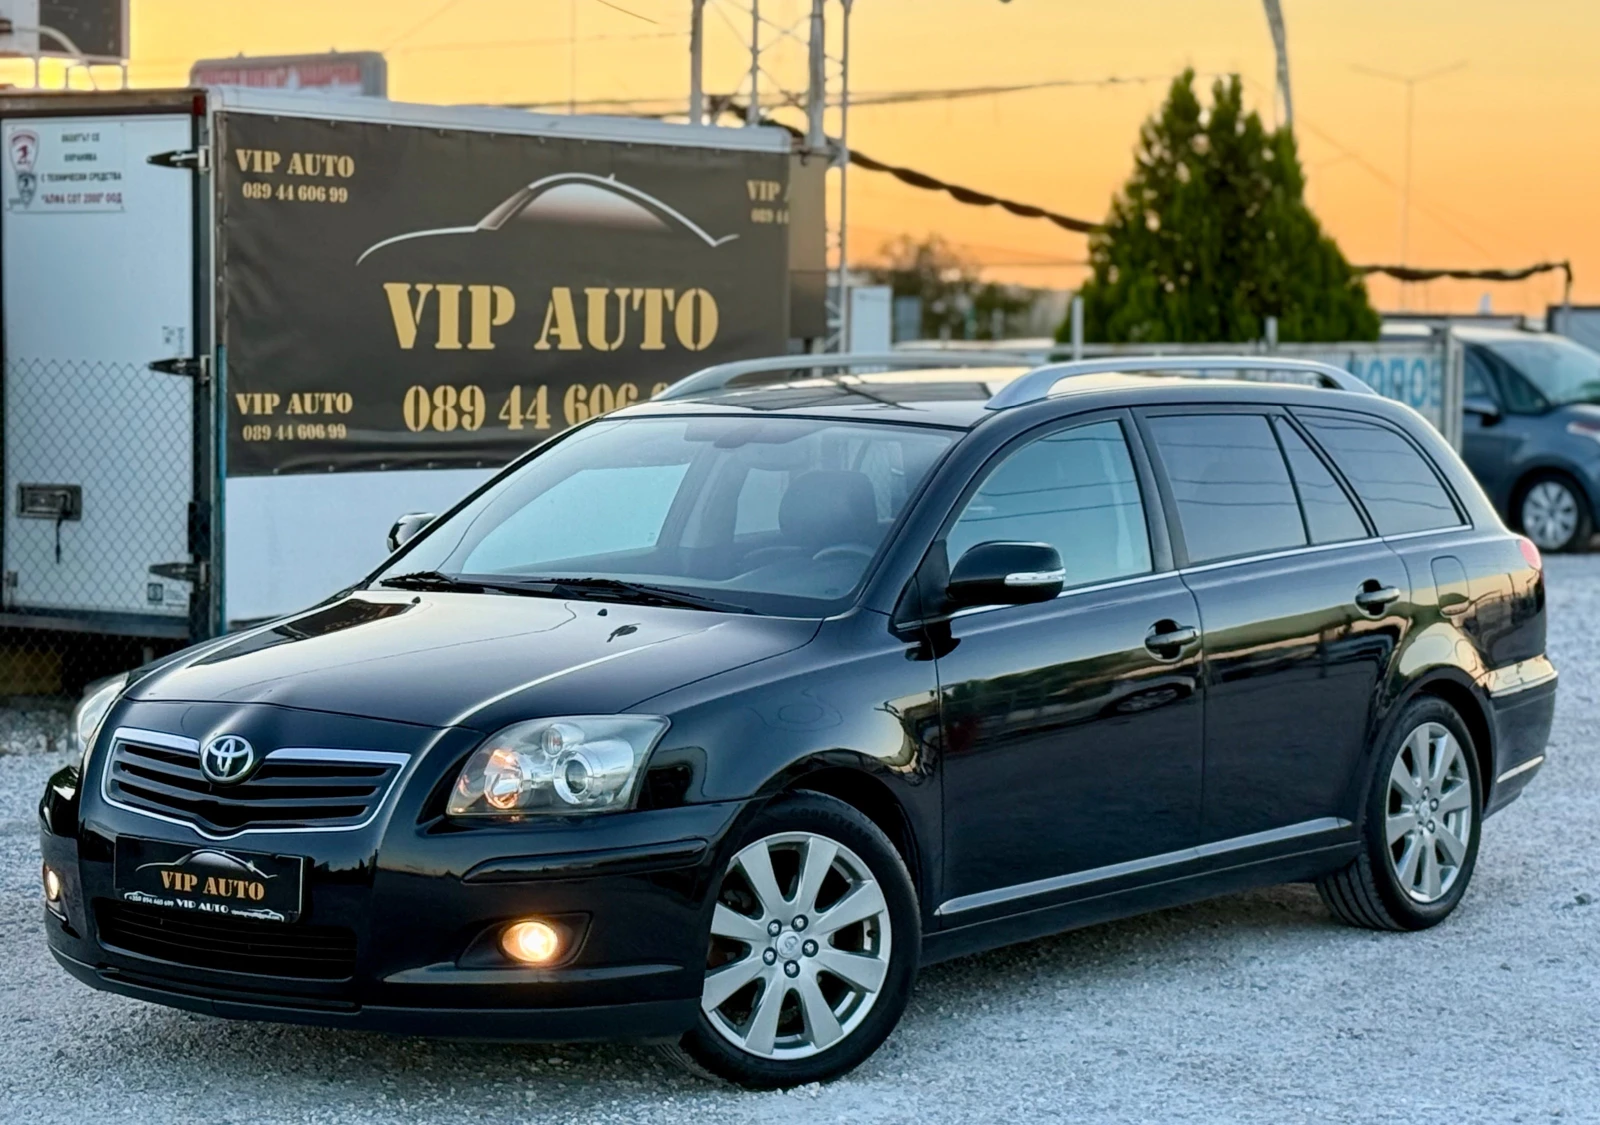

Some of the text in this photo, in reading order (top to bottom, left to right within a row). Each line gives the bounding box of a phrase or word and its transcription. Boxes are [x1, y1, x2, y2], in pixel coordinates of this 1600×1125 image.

[235, 148, 355, 178] VIP AUTO
[242, 181, 348, 203] 089 44 606 99
[746, 179, 781, 201] VIP
[383, 282, 719, 352] VIP AUTO
[235, 392, 353, 415] VIP AUTO
[403, 384, 486, 432] 089
[498, 384, 551, 430] 44
[242, 422, 347, 441] 089 44 606 99
[161, 870, 265, 901] VIP AUTO
[198, 902, 229, 914] AUTO
